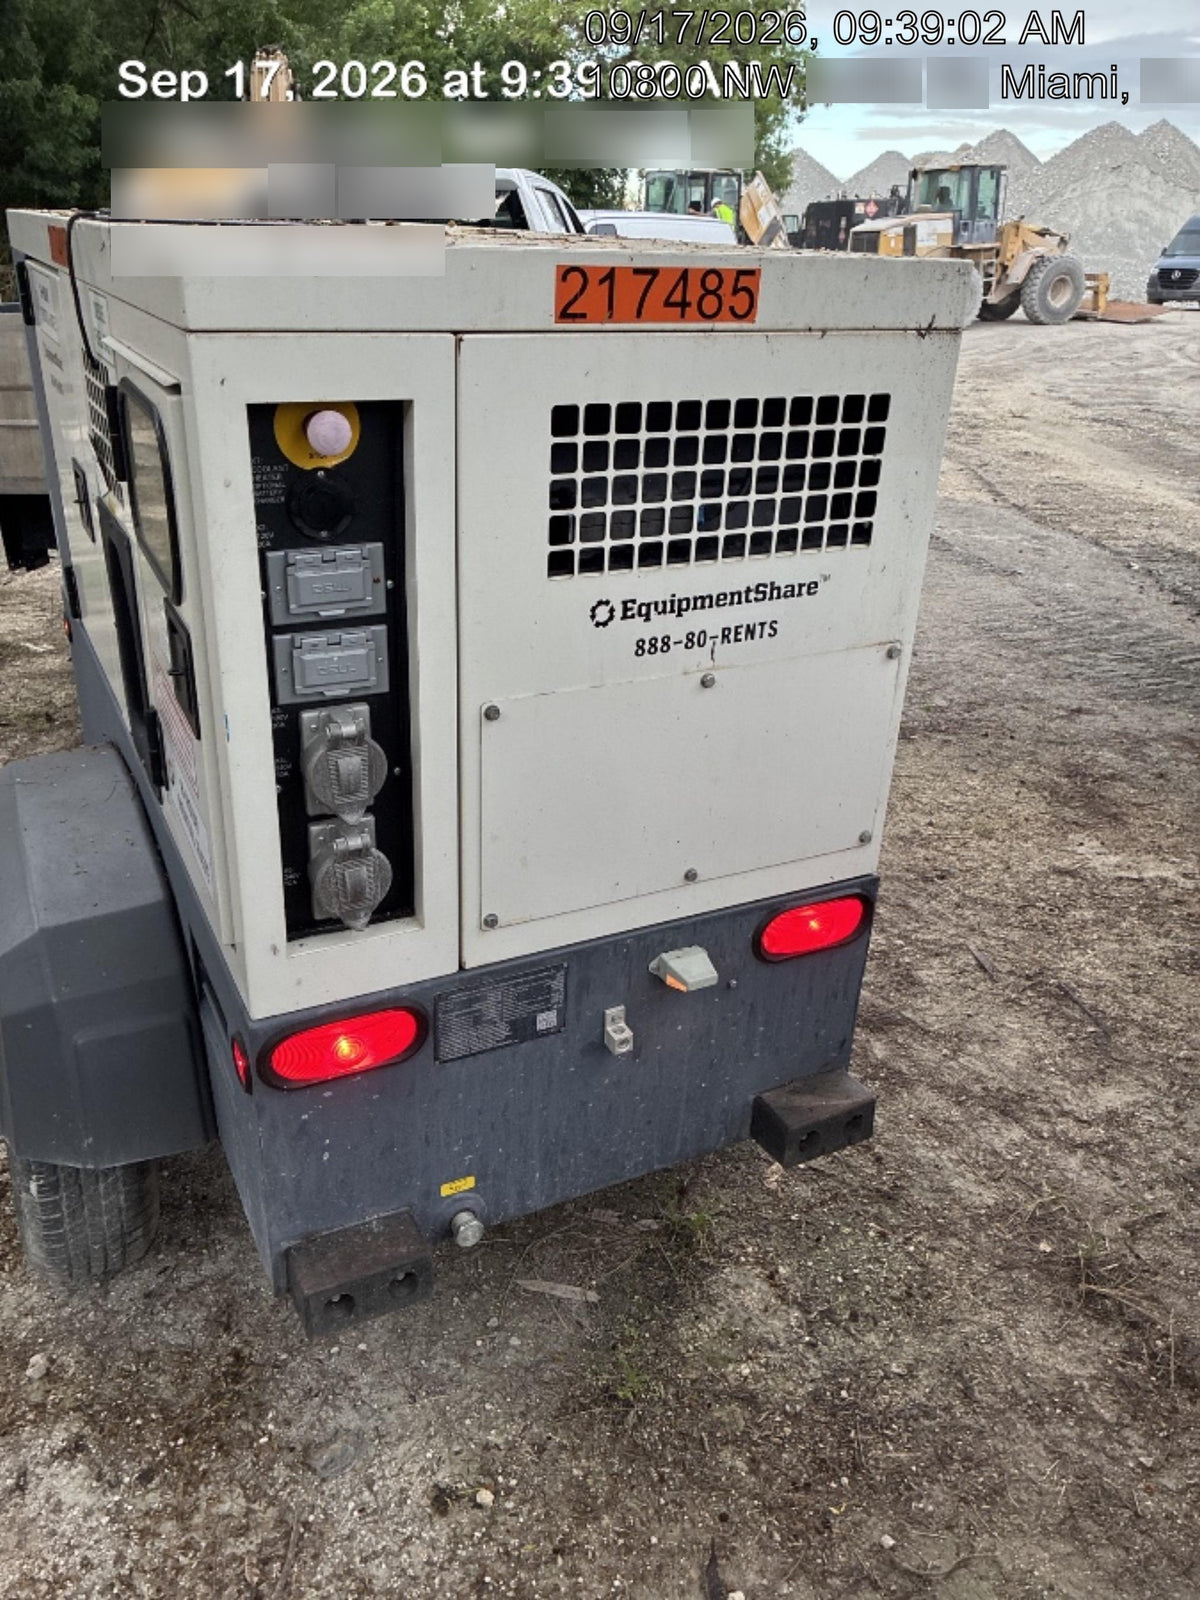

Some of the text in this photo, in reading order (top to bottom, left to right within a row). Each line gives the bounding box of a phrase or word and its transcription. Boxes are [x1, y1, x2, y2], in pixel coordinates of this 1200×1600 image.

[558, 265, 757, 320] 217485
[620, 579, 819, 622] EquipmentShare
[634, 619, 779, 657] 888-80-RENTS
